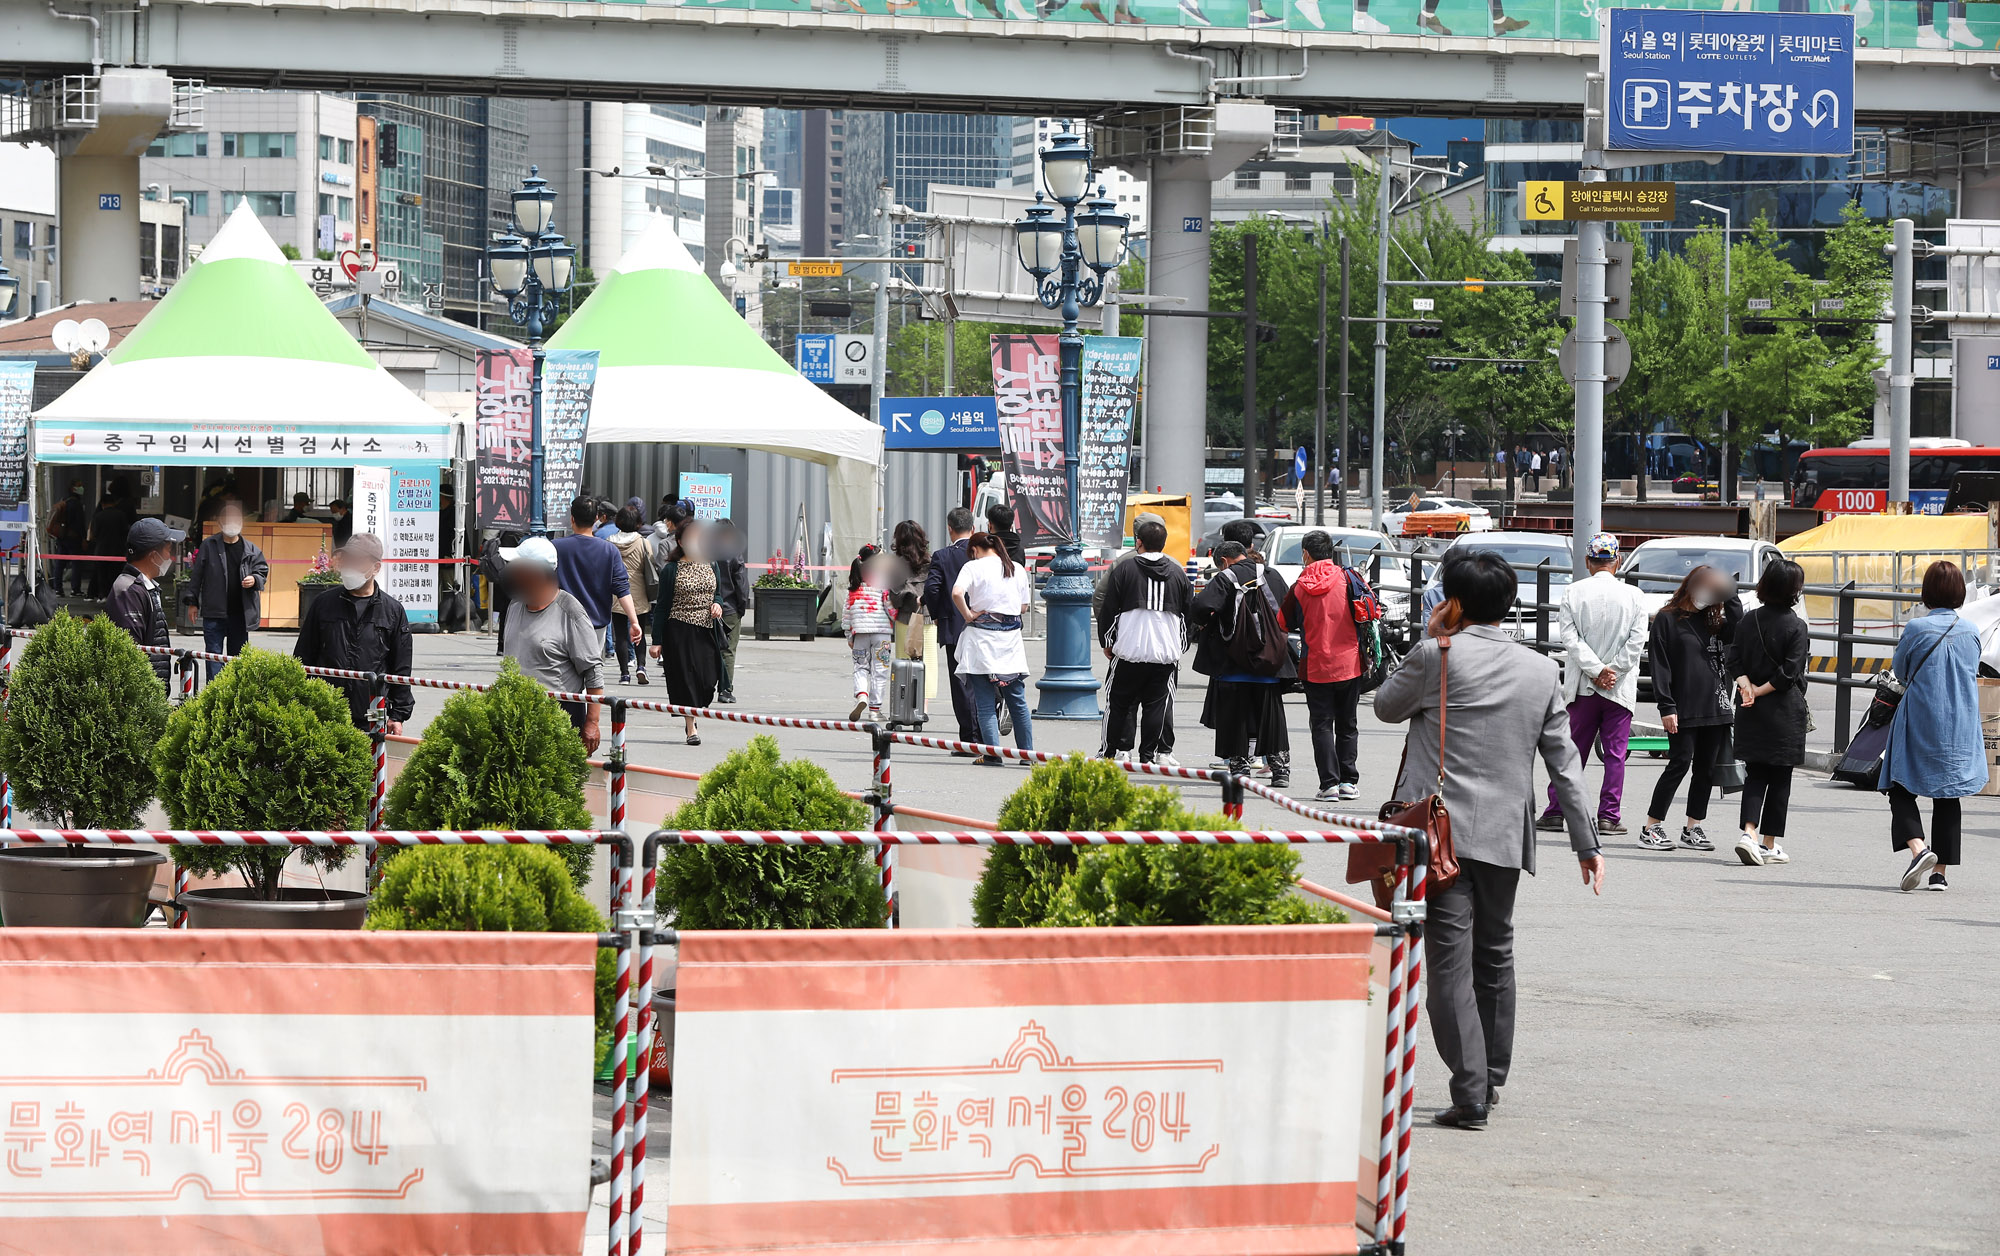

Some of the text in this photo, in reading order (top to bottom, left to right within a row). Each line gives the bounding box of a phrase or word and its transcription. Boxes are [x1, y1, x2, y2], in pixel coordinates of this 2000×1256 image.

[1622, 31, 1842, 53] 서울역 롯데아울렛 롯데마트
[1624, 51, 1670, 60] Seoul Station
[1634, 81, 1799, 132] P 주차장
[100, 197, 120, 208] P13
[1570, 190, 1668, 204] 장애인콜택시 승강장
[1184, 220, 1201, 230] P12
[794, 266, 837, 274] 방범CCTV
[312, 266, 332, 295] 혈
[424, 282, 445, 309] 집
[844, 368, 867, 376] 해제
[478, 376, 505, 450] 사이트
[504, 364, 532, 463] 보더리스
[996, 367, 1031, 454] 사이트
[1028, 353, 1062, 471] 보더리스
[949, 411, 984, 425] 서울역
[104, 434, 382, 454] 중구임시선별검사소
[362, 480, 384, 490] 코로나19
[400, 479, 431, 487] 코로나19
[398, 489, 432, 498] 선별검사
[690, 485, 722, 494] 코로나19
[398, 500, 432, 508] 순서안내
[1836, 492, 1875, 510] 1000
[406, 518, 416, 526] 소독
[424, 533, 434, 542] 작성
[399, 548, 418, 557] 검사라벨
[420, 548, 429, 557] 작성
[405, 594, 414, 602] 소독
[870, 1084, 1191, 1176] 문화역 서울 284
[4, 1099, 388, 1198] 문화역 서울 284
